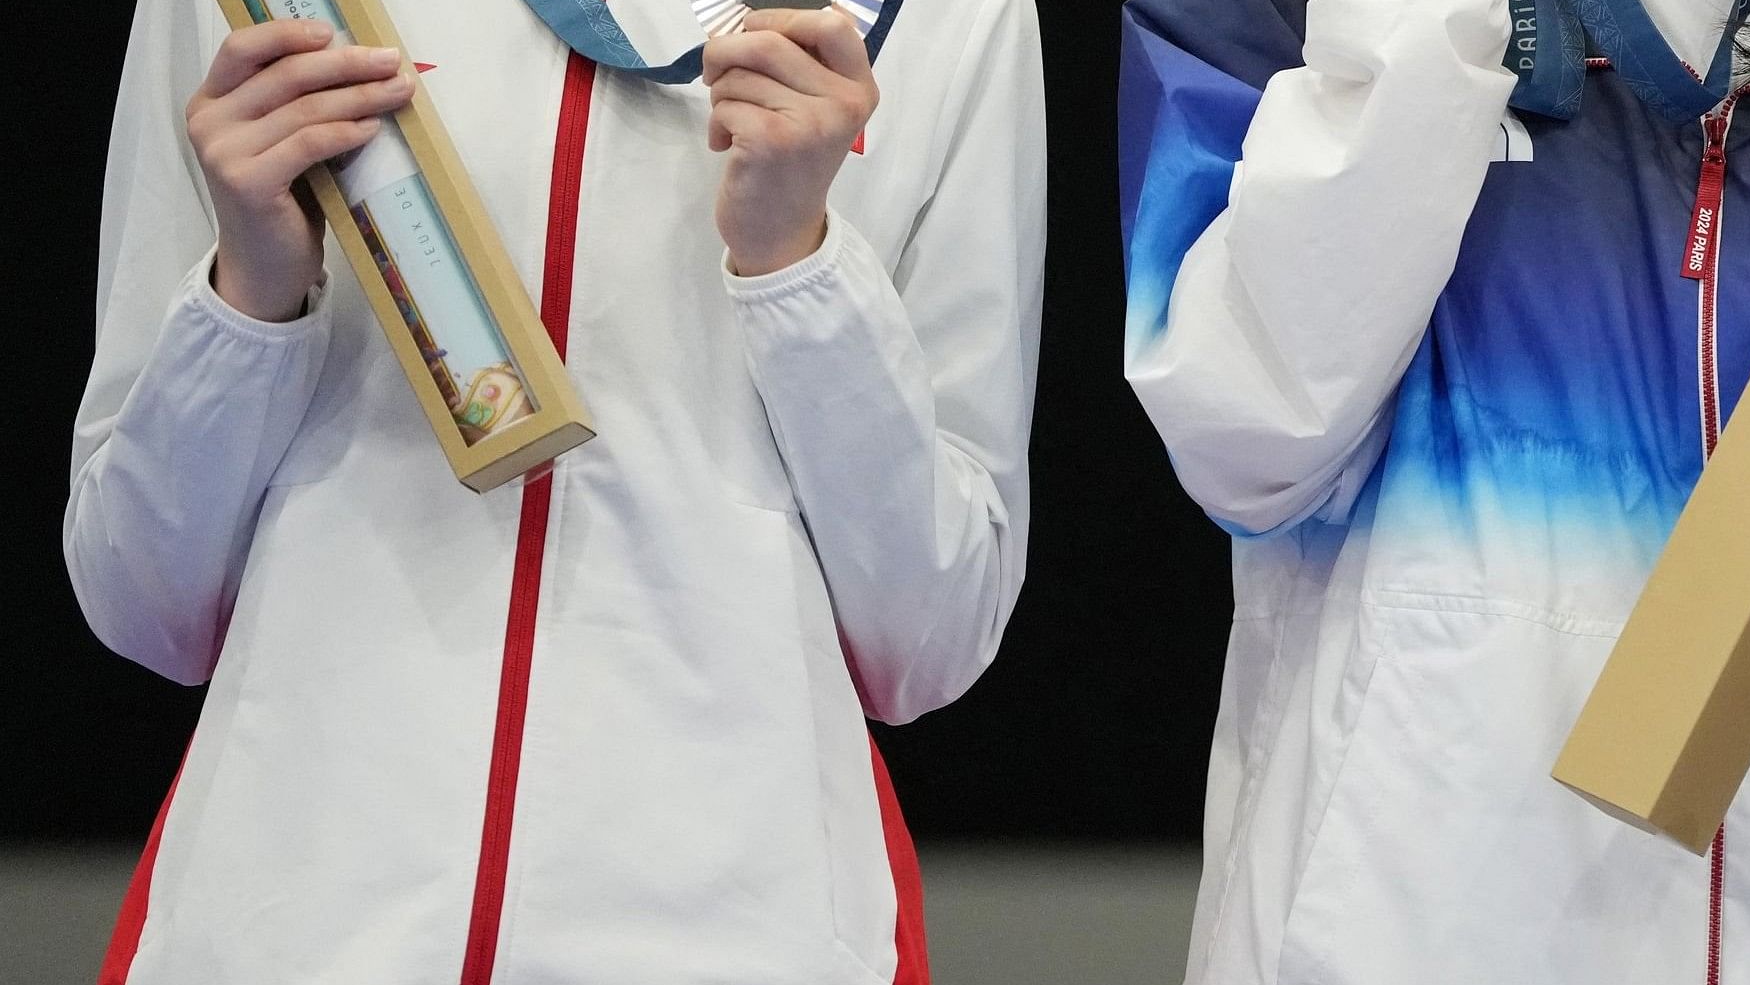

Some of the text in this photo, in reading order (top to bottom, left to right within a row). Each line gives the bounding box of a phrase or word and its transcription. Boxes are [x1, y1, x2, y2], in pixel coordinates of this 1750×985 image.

[394, 186, 413, 210] DE
[1689, 207, 1713, 271] 2024 PARIS
